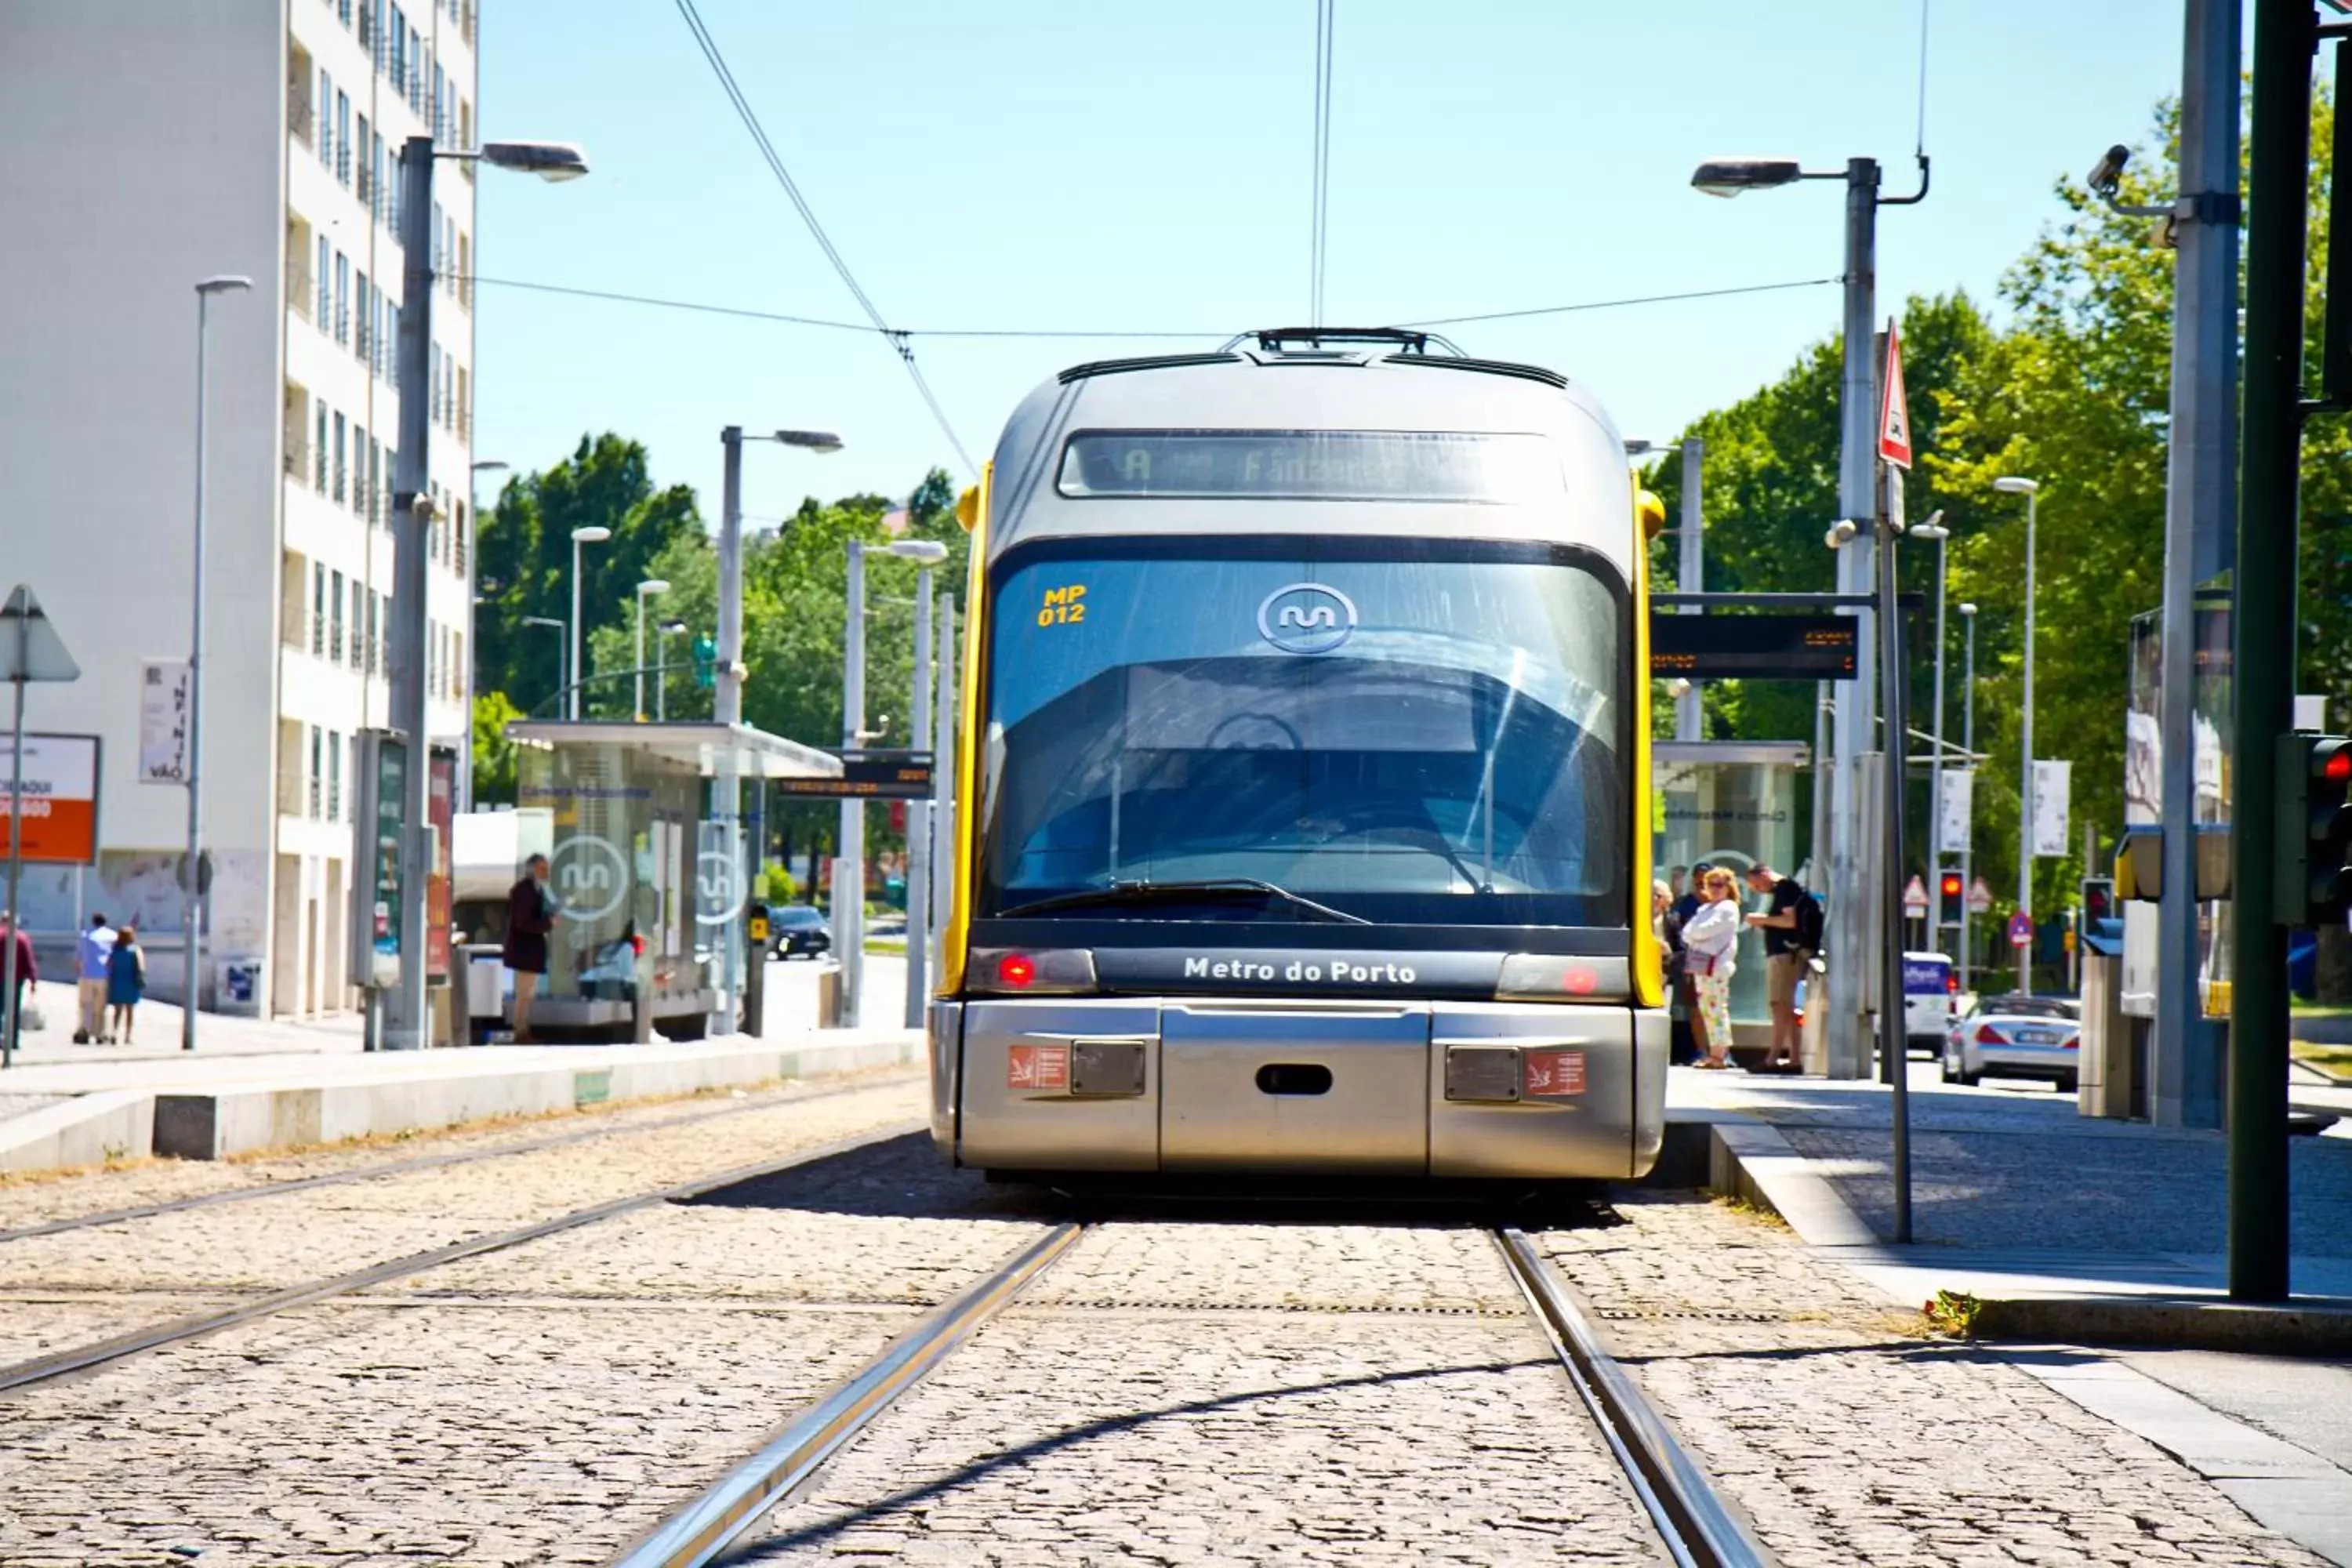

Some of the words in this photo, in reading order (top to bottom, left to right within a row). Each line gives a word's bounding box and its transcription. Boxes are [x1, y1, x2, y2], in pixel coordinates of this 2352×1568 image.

[1044, 584, 1087, 607] MP
[1037, 603, 1085, 626] 012
[1184, 956, 1275, 980] Metro
[1285, 960, 1321, 981] do
[1330, 960, 1417, 983] Porto
